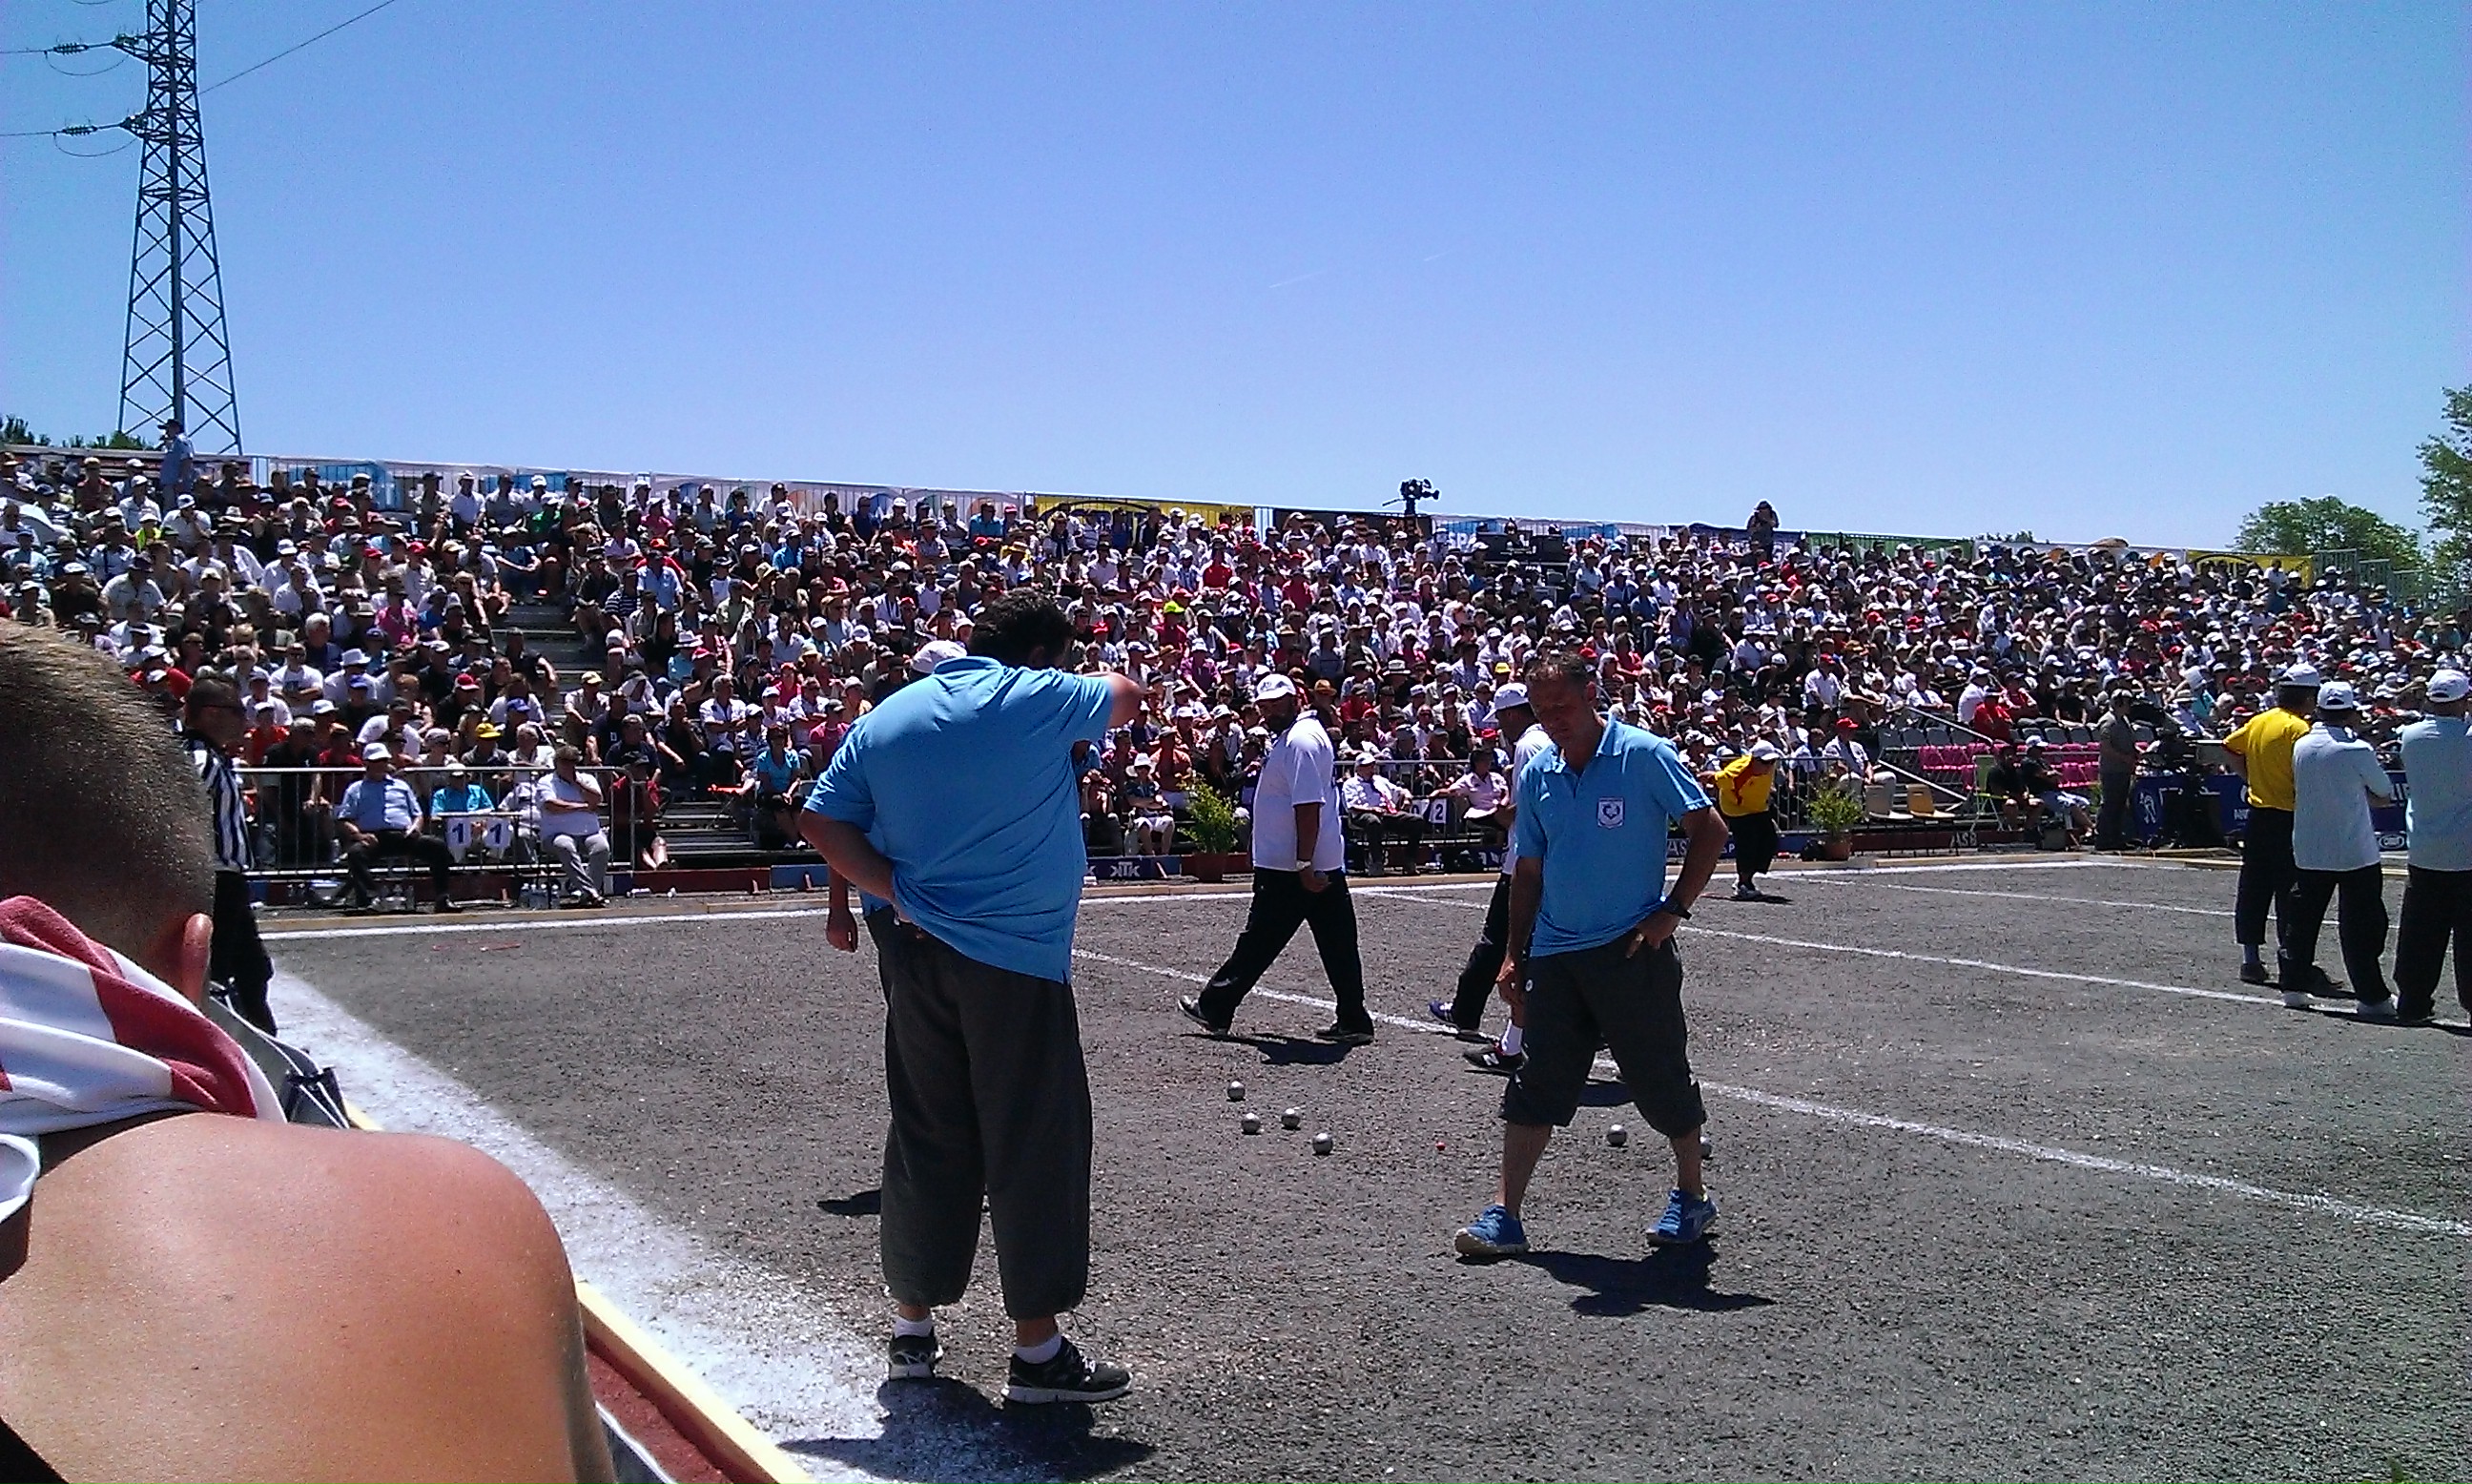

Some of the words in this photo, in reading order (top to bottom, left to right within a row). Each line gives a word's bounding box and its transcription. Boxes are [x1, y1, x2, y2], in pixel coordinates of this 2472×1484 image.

[1435, 804, 1443, 820] 2
[452, 823, 464, 844] 1
[489, 823, 502, 844] 1
